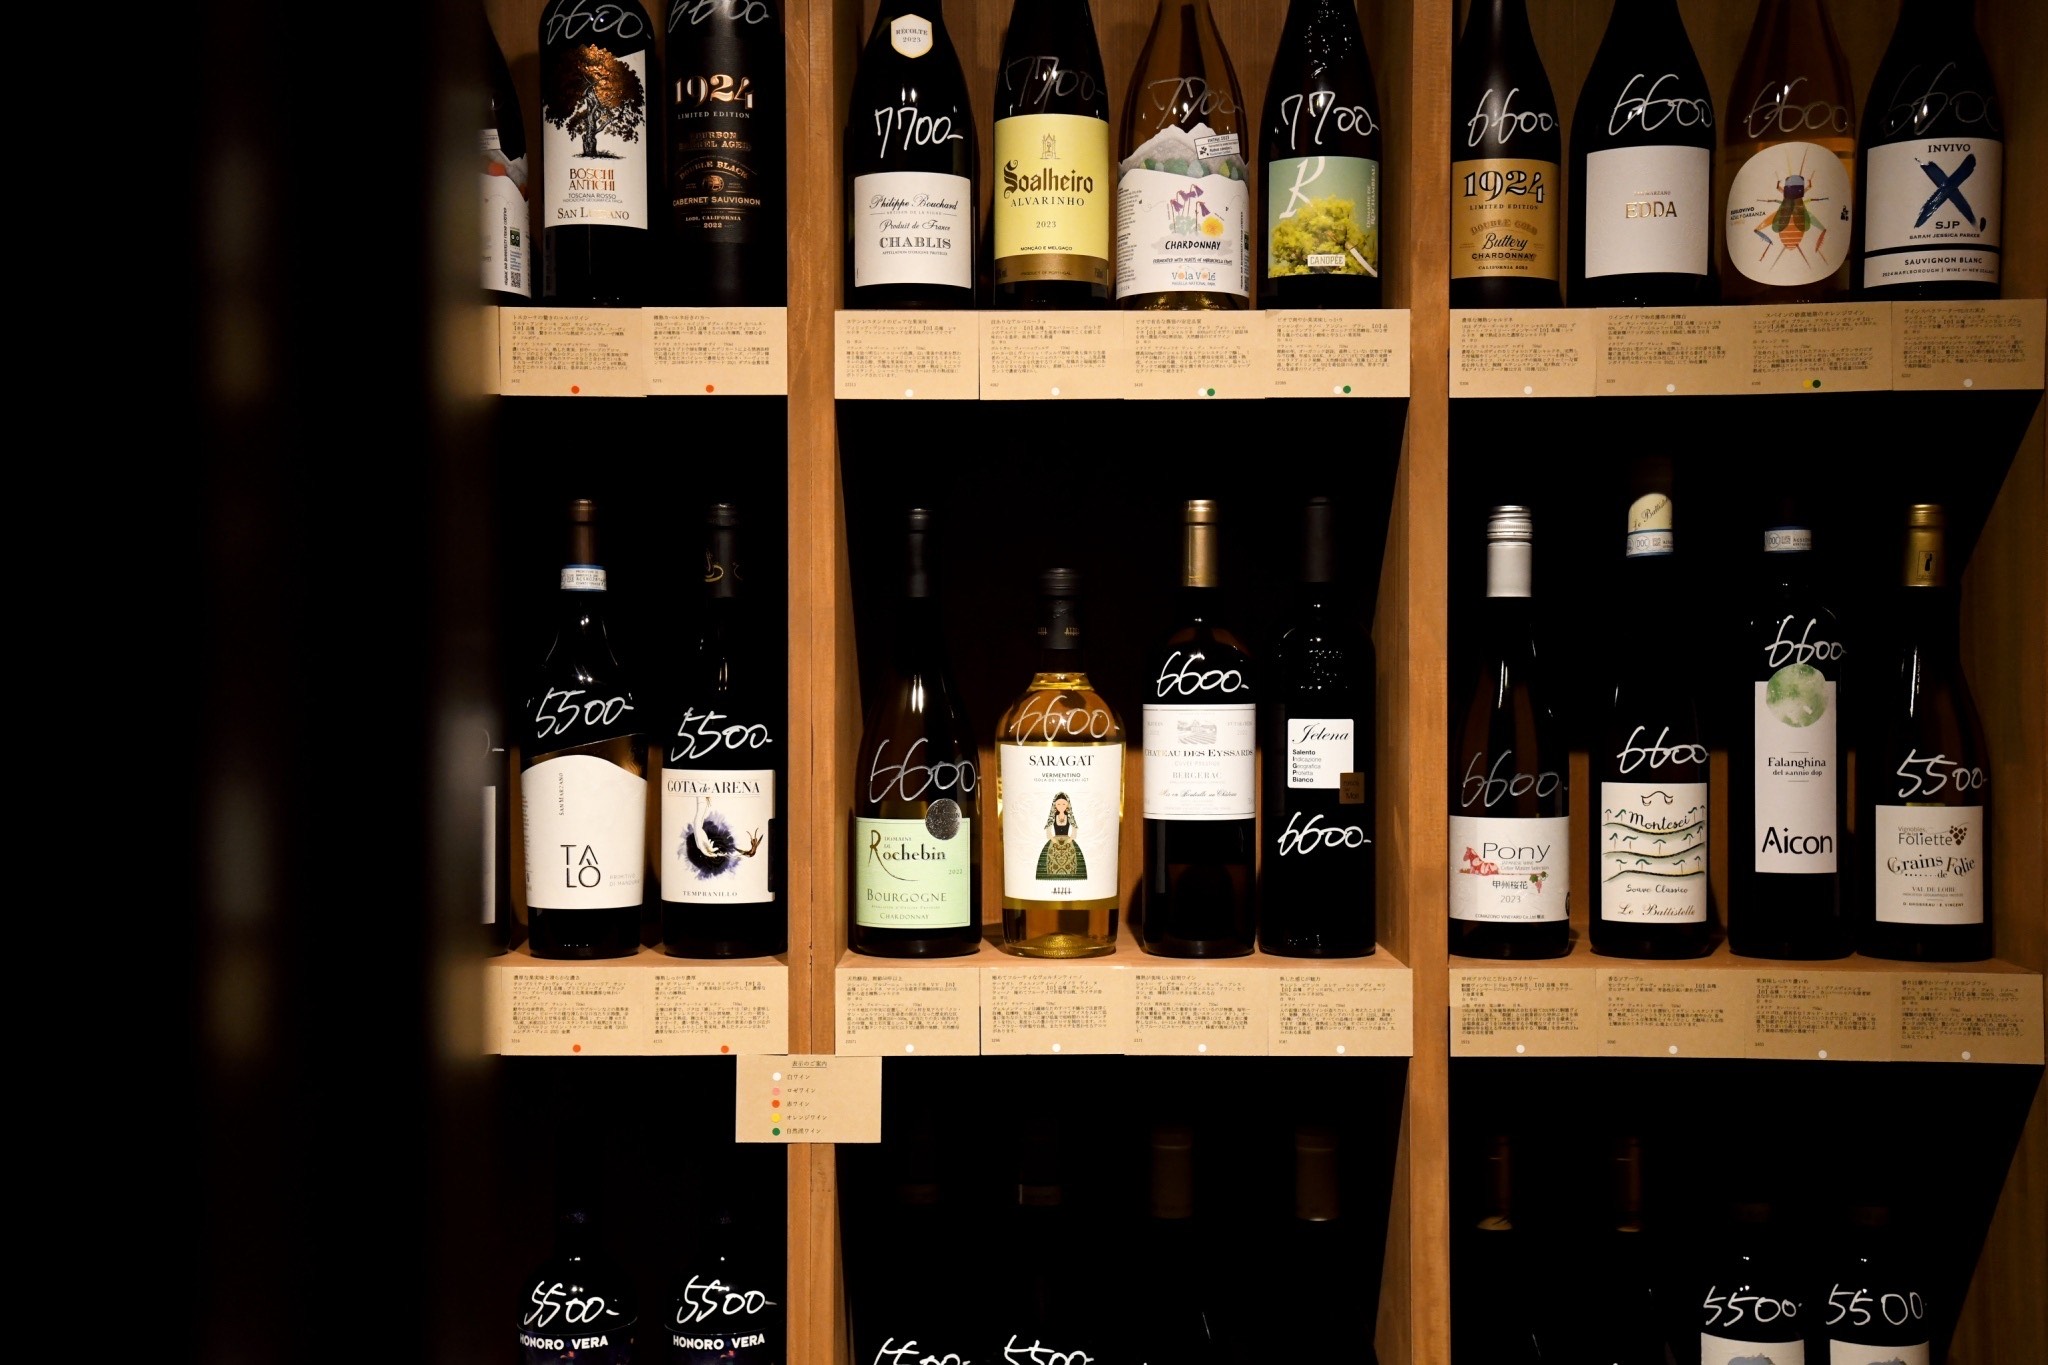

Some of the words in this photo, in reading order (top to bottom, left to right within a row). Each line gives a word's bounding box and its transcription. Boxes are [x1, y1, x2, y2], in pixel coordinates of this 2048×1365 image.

[675, 74, 754, 110] 1924
[678, 111, 710, 120] LIMITED
[713, 111, 750, 119] EDITION
[1927, 143, 1971, 153] INVIVO
[569, 168, 614, 180] BOSCHI
[716, 161, 748, 179] BLACK
[568, 180, 615, 191] ANTICHI
[1003, 160, 1093, 199] Soalheiro
[1463, 170, 1545, 203] 1924
[673, 196, 709, 207] CABERNET
[711, 196, 761, 205] SAUVIGNON
[869, 194, 910, 211] Philippe
[911, 193, 958, 210] Bouchard
[1010, 196, 1085, 207] ALVARINHO
[1469, 203, 1504, 211] LIMITED
[557, 207, 578, 220] SAN
[1625, 200, 1678, 219] EDDA
[879, 218, 910, 233] Produit
[911, 221, 920, 229] de
[921, 219, 951, 231] France
[1036, 220, 1057, 229] 2023
[1935, 220, 1960, 229] SJP
[879, 236, 951, 249] CHABLIS
[1165, 240, 1221, 251] CHARDONNAY
[1481, 232, 1529, 251] Buttery
[1309, 255, 1344, 266] CANOPÉE
[1471, 252, 1535, 260] CHARDONNAY
[1904, 257, 1957, 266] SAUVIGNON
[1893, 268, 1940, 276] MARLBOROUGH
[1291, 722, 1349, 745] Jelena
[1208, 749, 1253, 757] EYSSARDS
[1029, 755, 1095, 767] SARAGAT
[1292, 762, 1322, 770] Geografica
[1767, 756, 1826, 769] Falanghina
[1172, 771, 1222, 779] BERGERAC
[1810, 769, 1823, 777] dop
[667, 780, 697, 793] GOTA
[699, 782, 711, 793] de
[711, 781, 760, 794] ARENA
[1628, 811, 1691, 831] Montesei
[1761, 826, 1833, 855] Aicon
[1898, 832, 1953, 846] Foliette
[867, 829, 947, 882] Rochebin
[1482, 842, 1551, 863] Pony
[1887, 854, 1944, 875] Grains
[1946, 856, 1976, 877] Folie
[1937, 869, 1948, 879] de
[1492, 880, 1528, 890] 甲州桜花
[1655, 884, 1688, 893] Classico
[867, 888, 947, 902] BOURGOGNE
[1500, 895, 1521, 904] 2023
[1618, 903, 1634, 915] Le
[792, 1060, 828, 1068] 表示のご案内
[786, 1127, 822, 1135] 自然派ワイン
[520, 1333, 565, 1350] HONORO
[571, 1334, 609, 1350] VERA
[673, 1333, 724, 1350] HONORO
[731, 1333, 766, 1350] VERA
